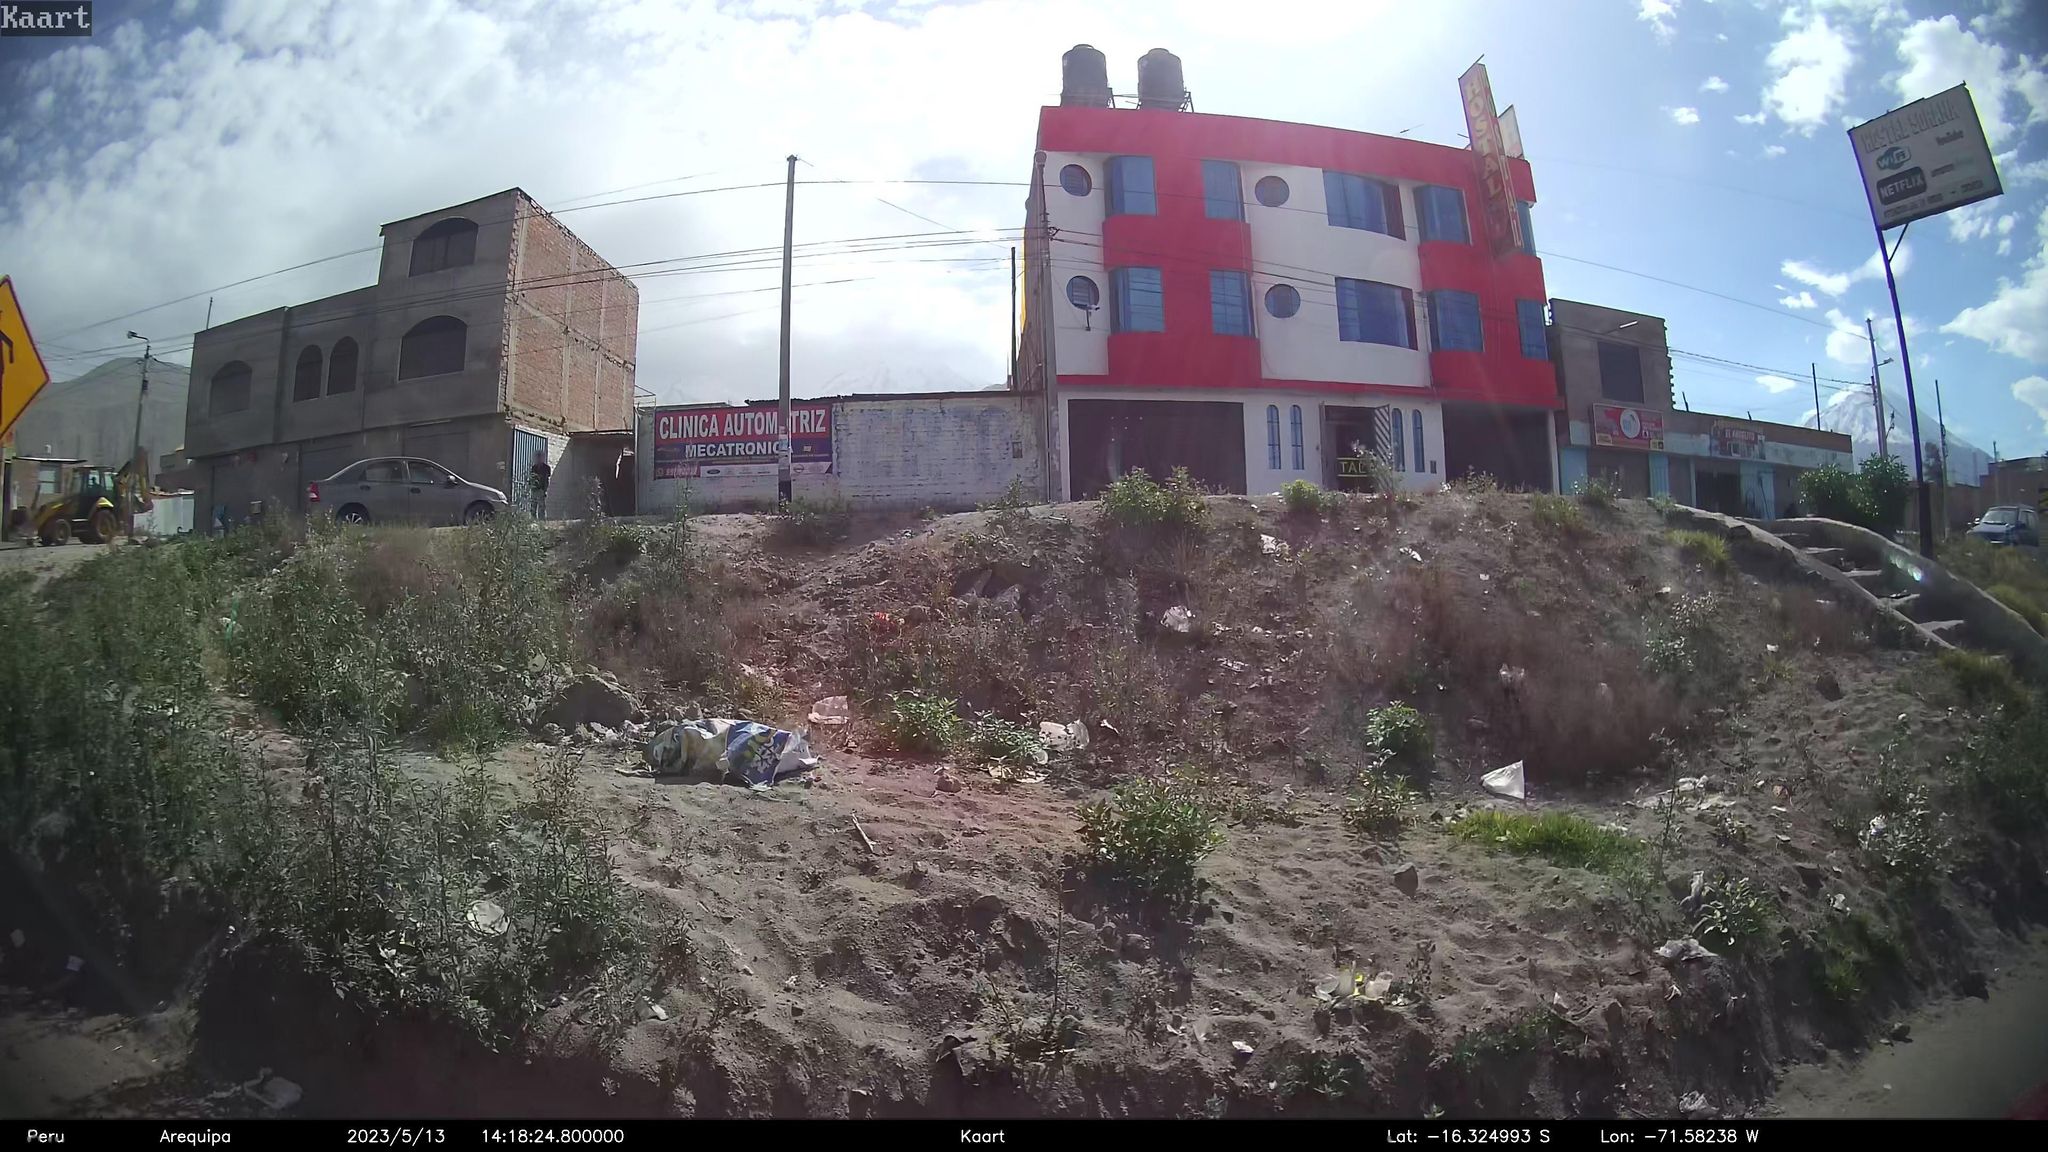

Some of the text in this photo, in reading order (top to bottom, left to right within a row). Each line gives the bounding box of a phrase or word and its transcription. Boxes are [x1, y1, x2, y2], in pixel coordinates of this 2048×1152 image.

[1880, 174, 1925, 197] NETFLIX
[659, 409, 826, 440] CLINICA AUTOMTRIZ
[1340, 460, 1374, 475] TAL
